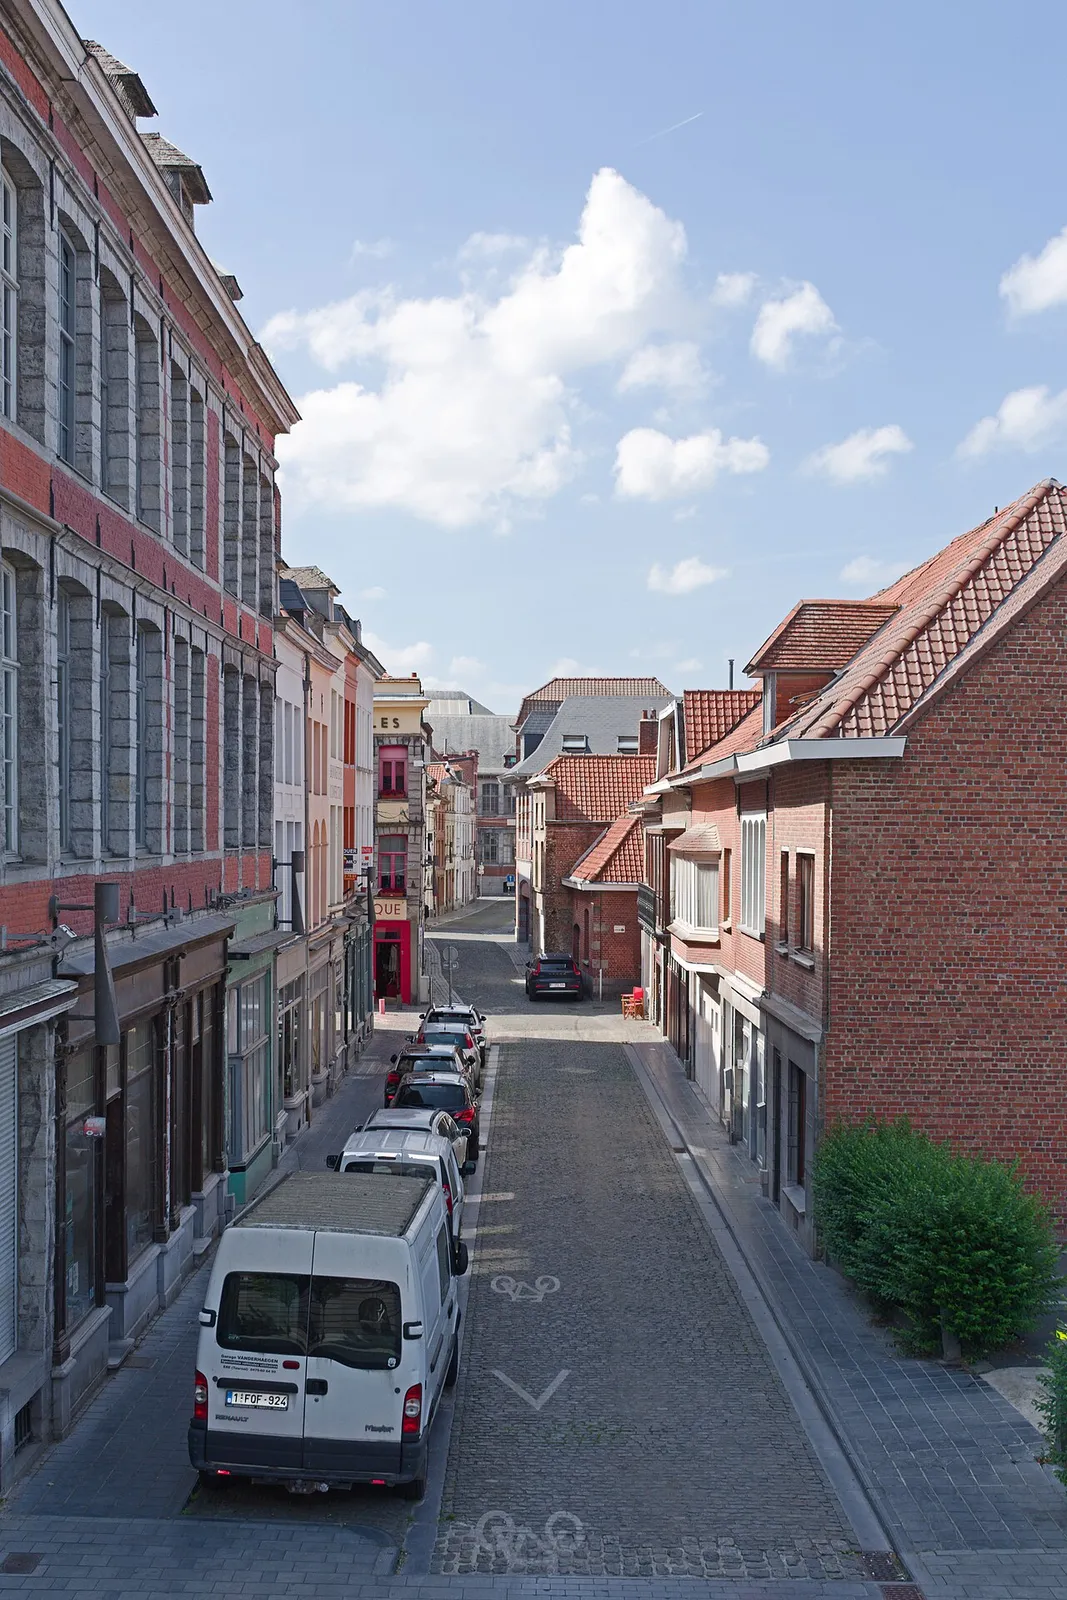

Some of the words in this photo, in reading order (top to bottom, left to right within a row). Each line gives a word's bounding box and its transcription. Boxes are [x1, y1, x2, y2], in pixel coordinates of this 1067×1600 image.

[373, 717, 400, 729] ES
[215, 1414, 249, 1422] RENAULT
[364, 1424, 395, 1433] Master
